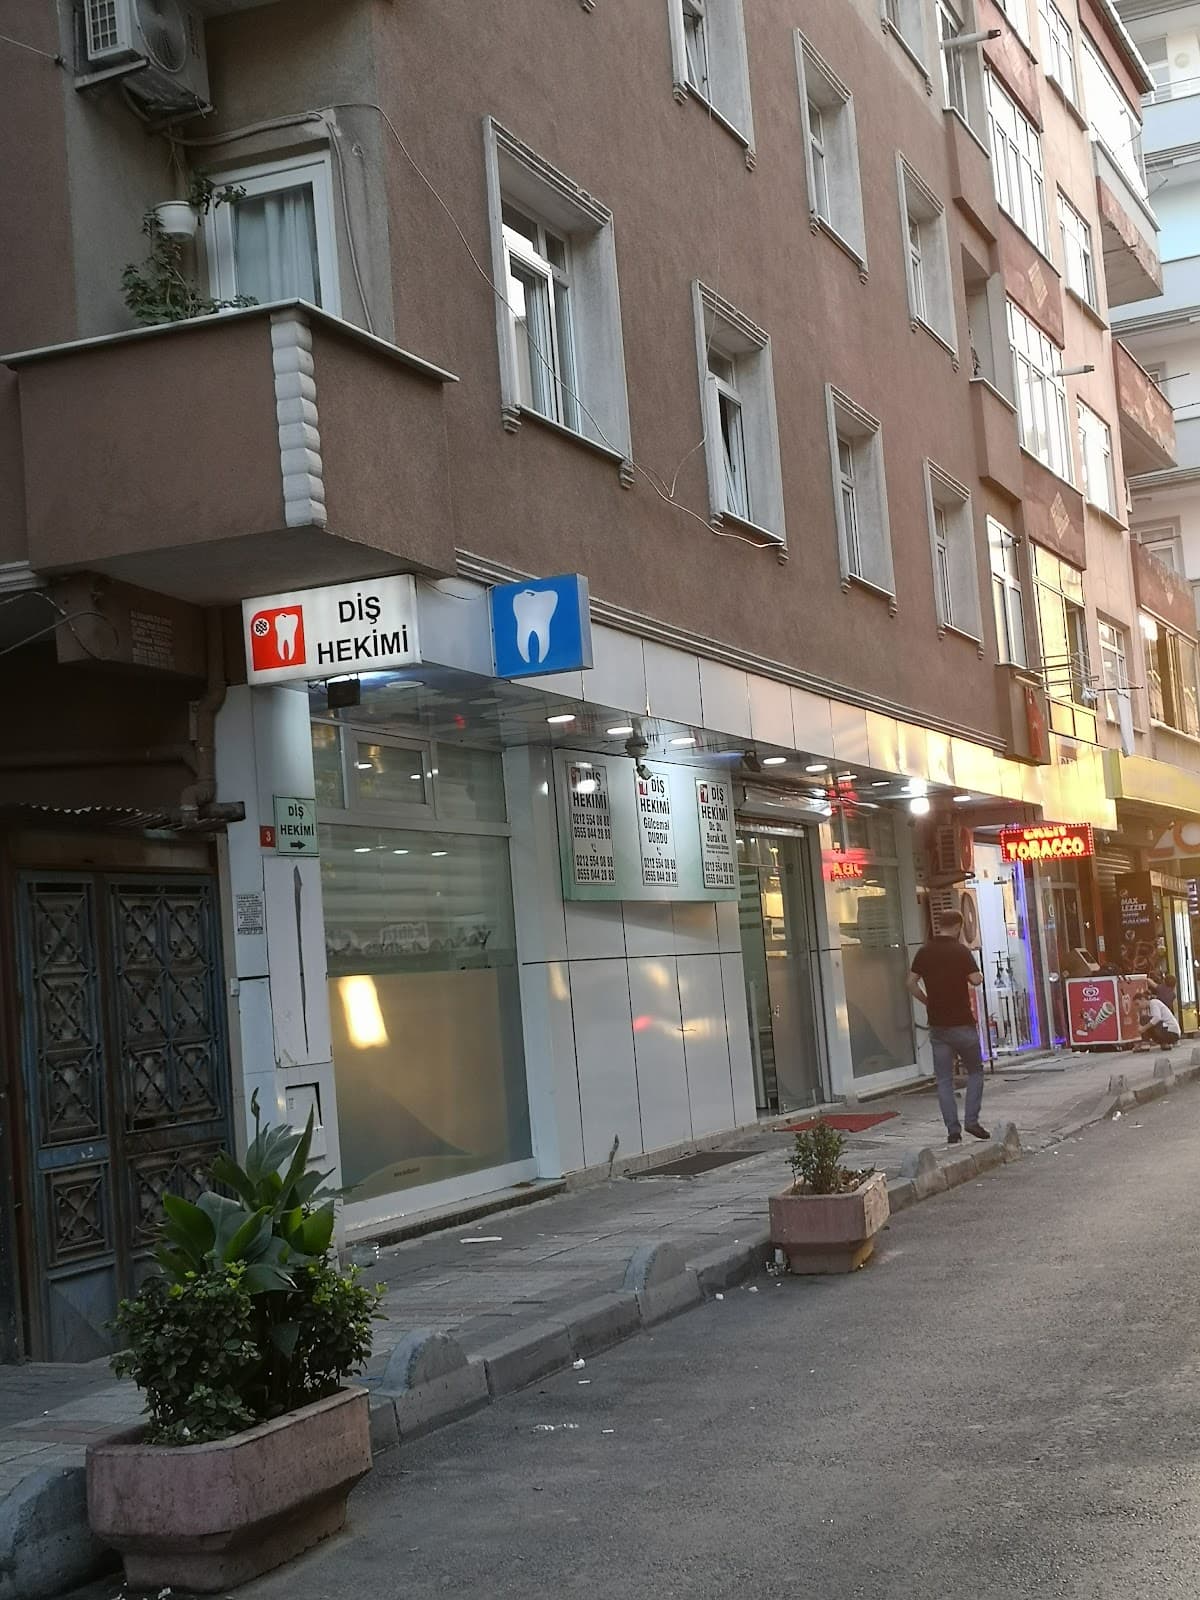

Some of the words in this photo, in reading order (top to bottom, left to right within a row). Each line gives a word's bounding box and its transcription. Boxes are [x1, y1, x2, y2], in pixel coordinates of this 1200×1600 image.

[338, 593, 381, 625] DİŞ
[317, 624, 410, 665] HEKİMİ
[585, 770, 601, 791] DİŞ
[651, 776, 665, 798] DİŞ
[711, 785, 724, 804] DİŞ
[288, 804, 304, 819] DİŞ
[640, 797, 670, 815] HEKİMİ
[701, 804, 728, 821] HEKİMİ
[265, 831, 272, 842] 3
[280, 823, 314, 836] HEKİMİ
[1006, 837, 1085, 858] TOBACCO
